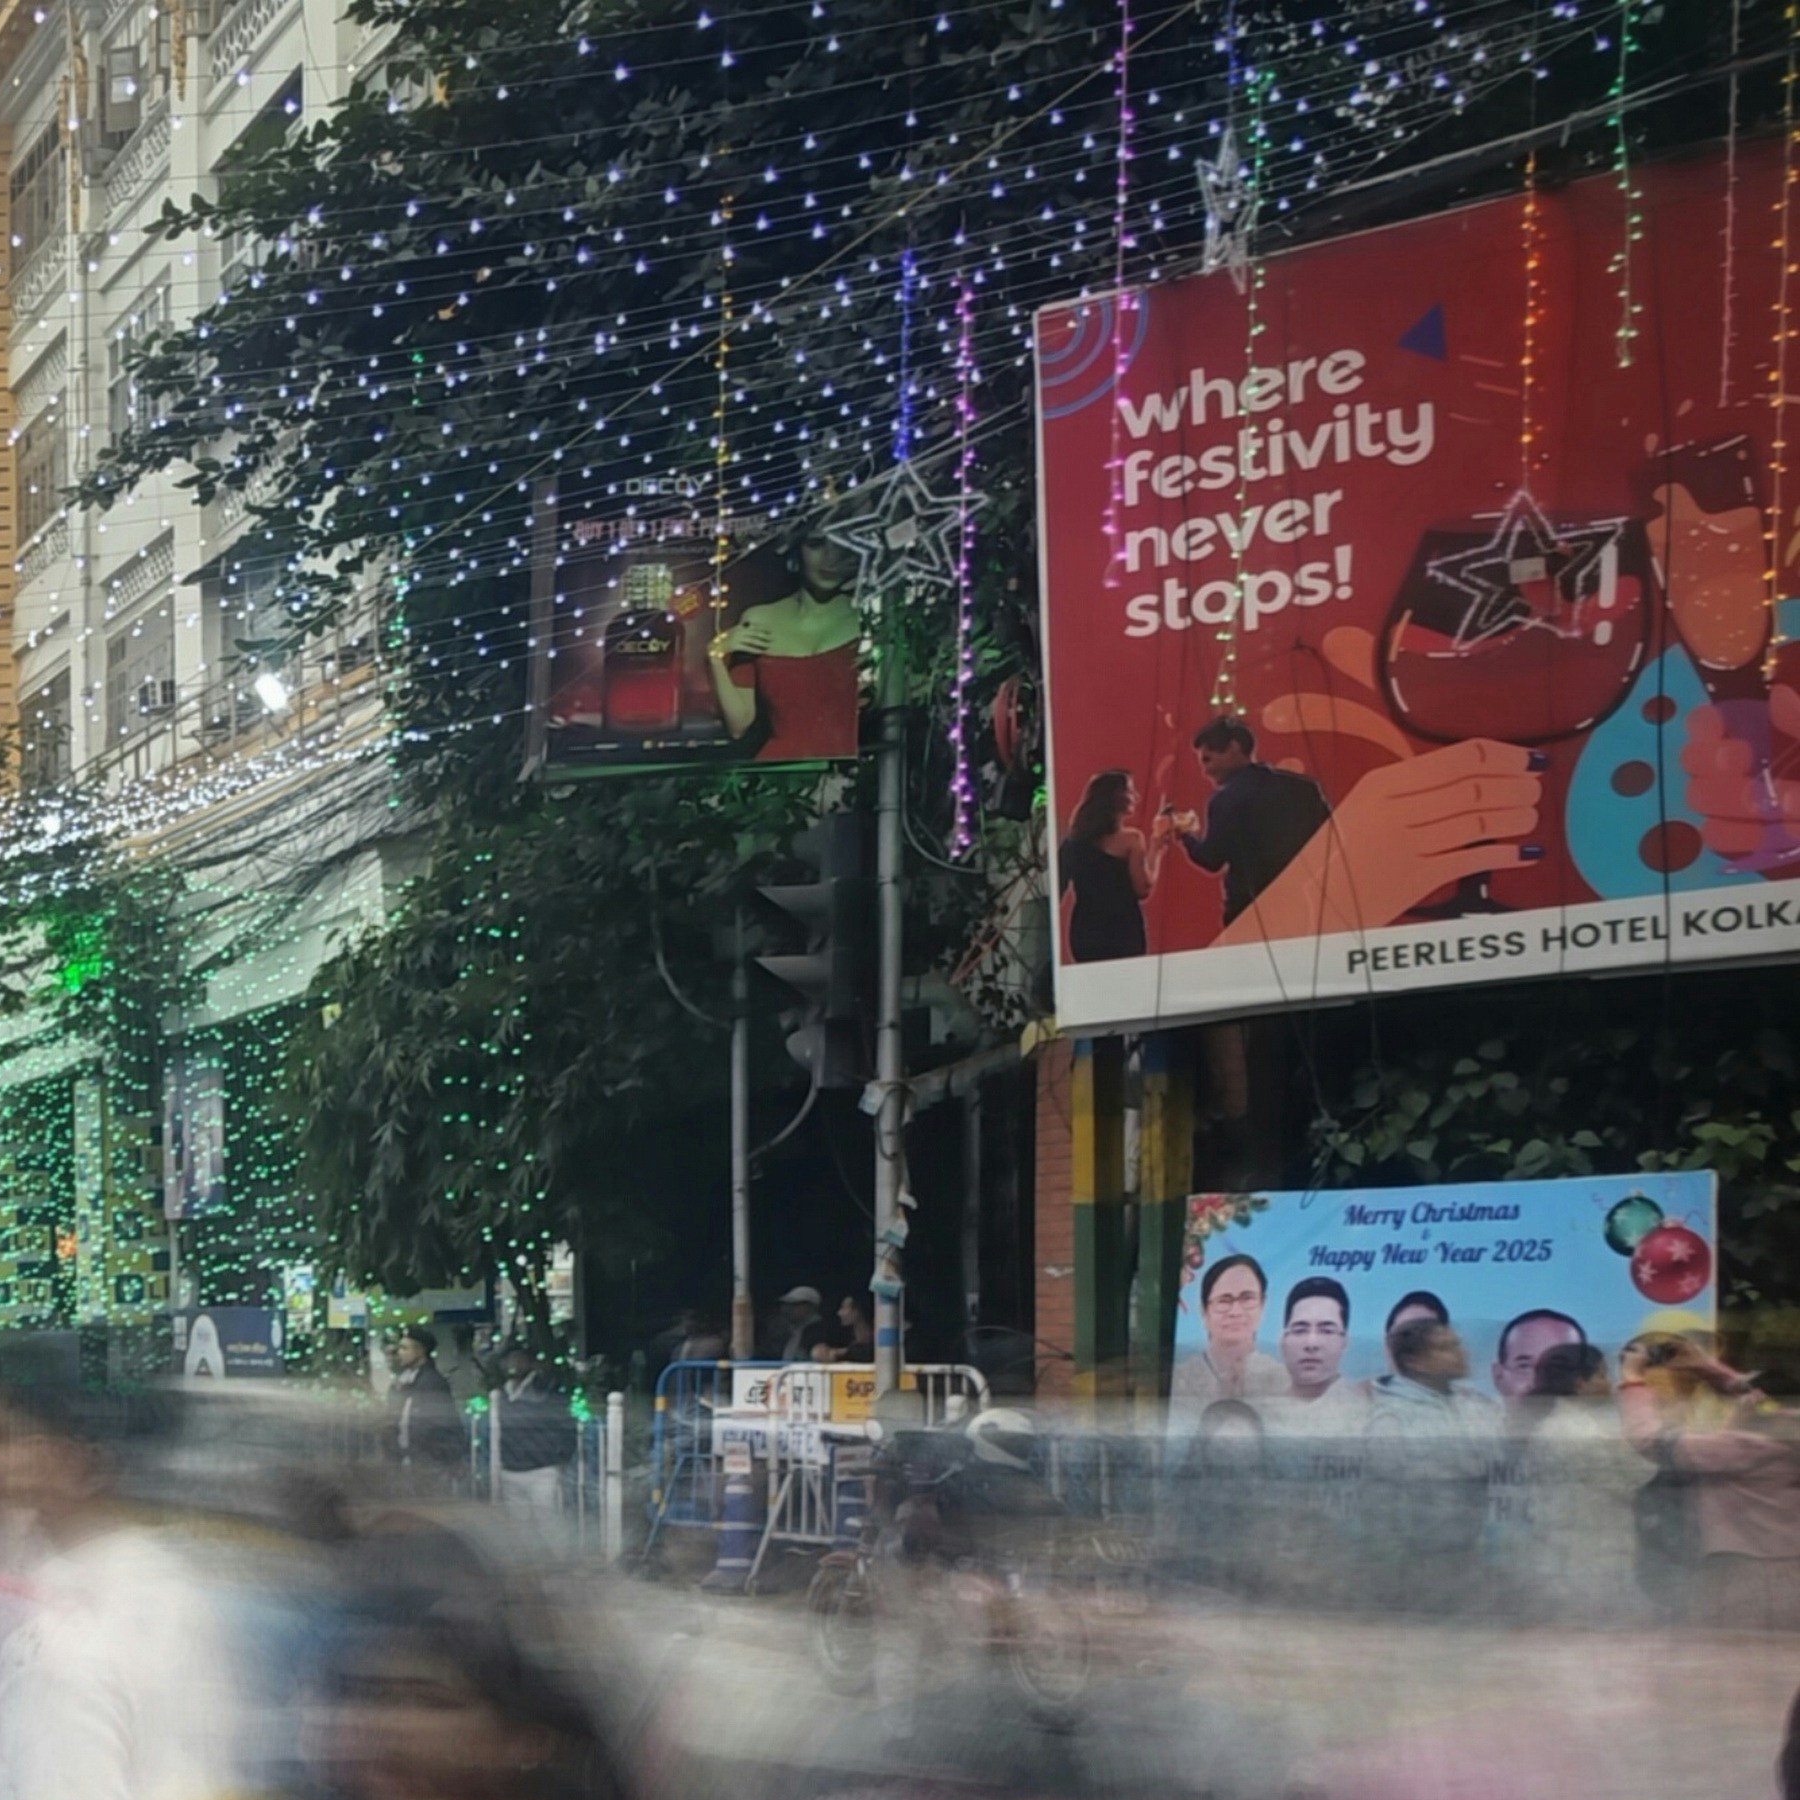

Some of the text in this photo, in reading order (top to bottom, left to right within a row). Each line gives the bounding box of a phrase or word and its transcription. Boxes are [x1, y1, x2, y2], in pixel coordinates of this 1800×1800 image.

[1118, 349, 1366, 439] where
[1124, 402, 1435, 507] festivity
[1125, 489, 1343, 573] never
[1124, 544, 1353, 637] stops!
[1347, 899, 1800, 974] PEERLESS HOTEL KOLK
[1309, 1238, 1553, 1272] Happy New Year 2025
[1344, 1201, 1521, 1230] Merry Christmas
